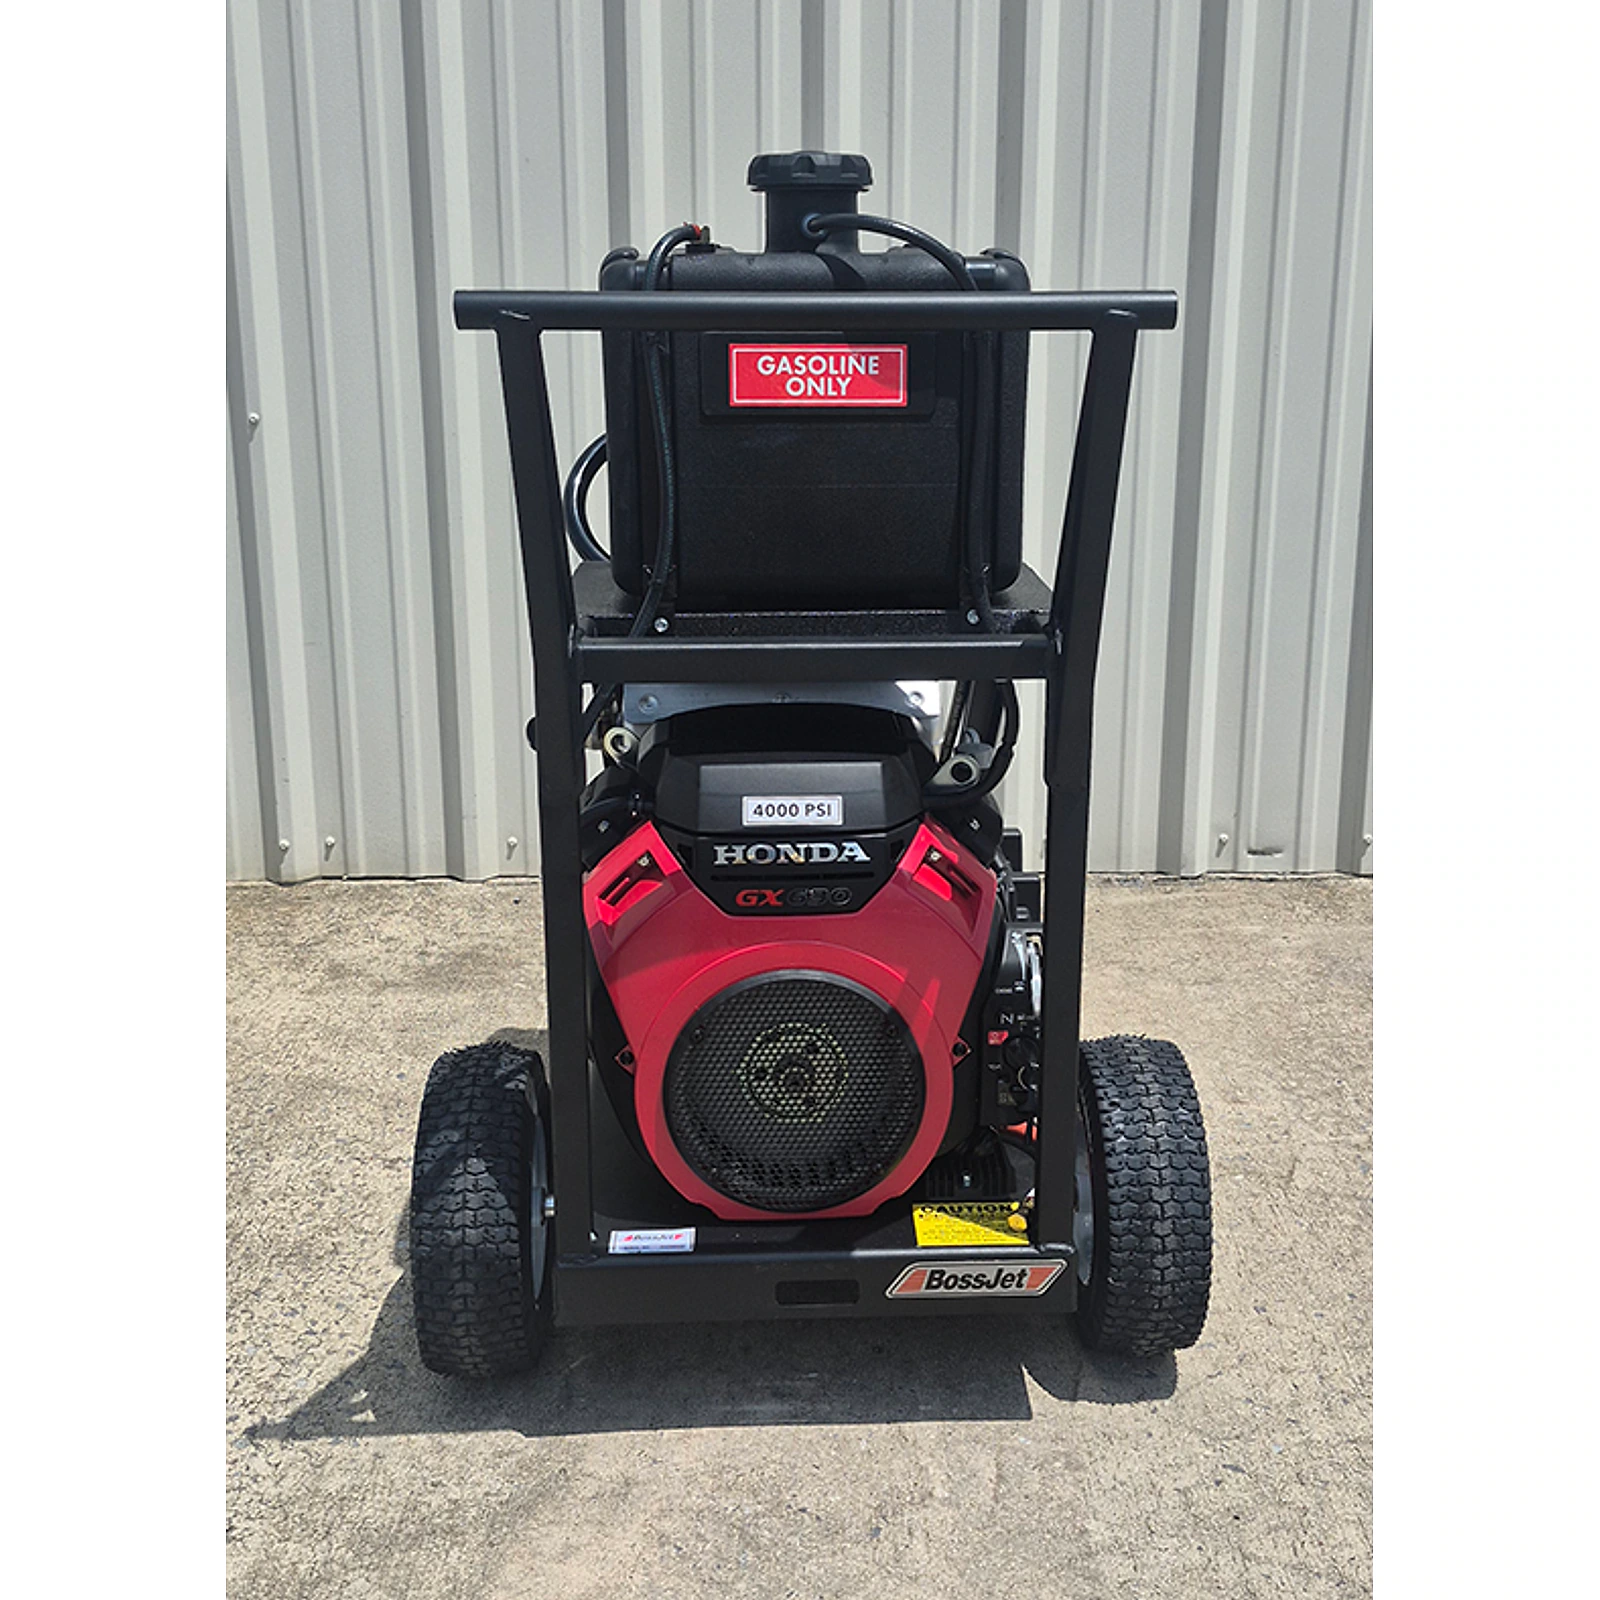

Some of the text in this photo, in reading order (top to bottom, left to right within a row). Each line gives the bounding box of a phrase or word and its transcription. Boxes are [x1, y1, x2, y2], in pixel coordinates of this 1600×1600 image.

[757, 355, 880, 376] GASOLINE
[785, 377, 851, 397] ONLY
[753, 803, 832, 817] 4000 PSI
[713, 841, 872, 865] HONDA
[924, 1267, 1029, 1291] BossJet
